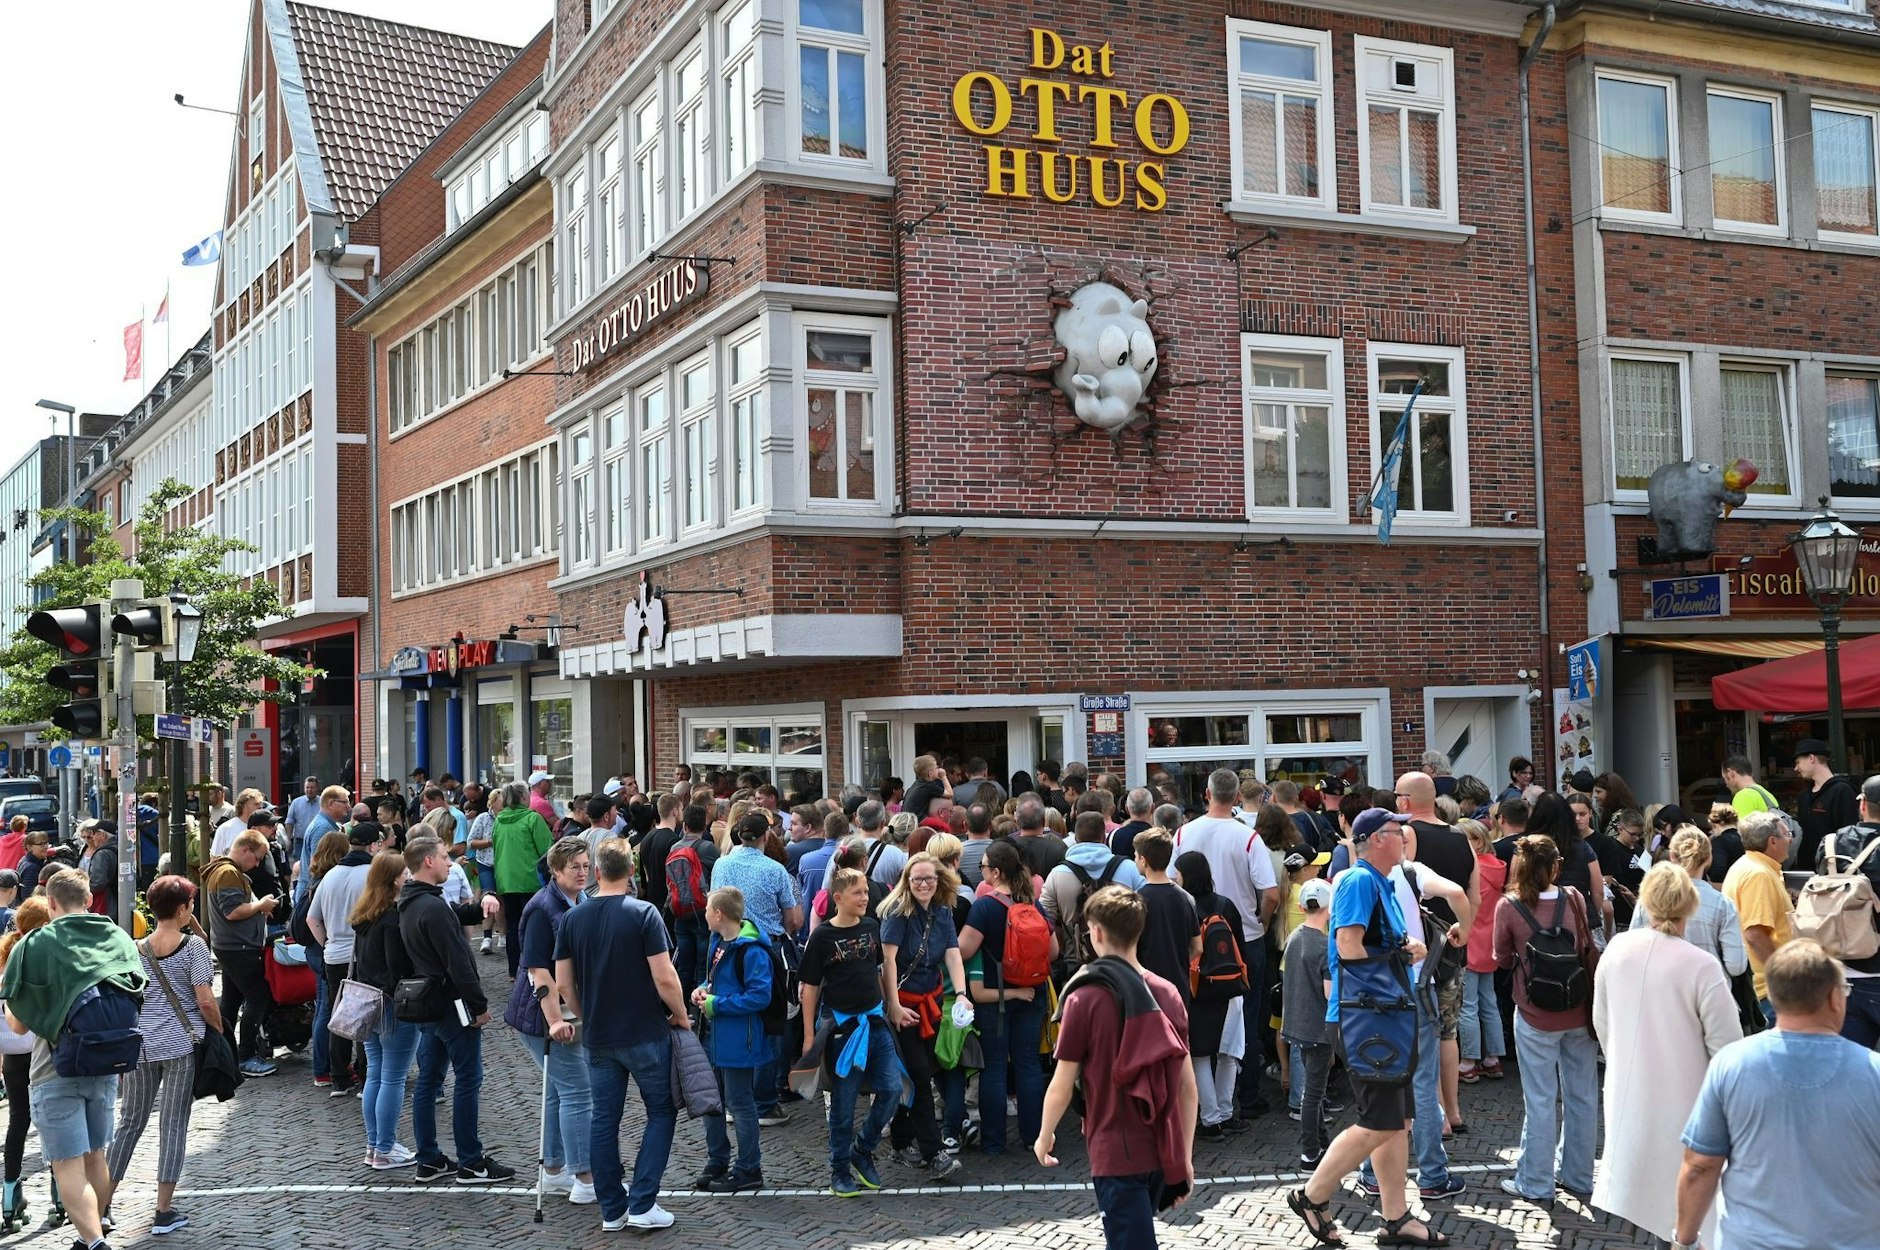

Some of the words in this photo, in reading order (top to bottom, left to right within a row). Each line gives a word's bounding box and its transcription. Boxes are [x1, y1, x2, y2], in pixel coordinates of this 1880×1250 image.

[1028, 27, 1115, 78] Dat
[952, 71, 1191, 155] OTTO
[981, 144, 1168, 212] HUUS
[572, 331, 595, 374] Dat
[598, 293, 643, 354] OTTO
[645, 252, 697, 323] HUUS
[1673, 580, 1700, 595] EIS
[458, 640, 491, 668] PLAY
[1570, 664, 1583, 677] Eis
[1083, 696, 1104, 709] Große
[1105, 696, 1128, 709] Straße
[1405, 723, 1411, 732] 1
